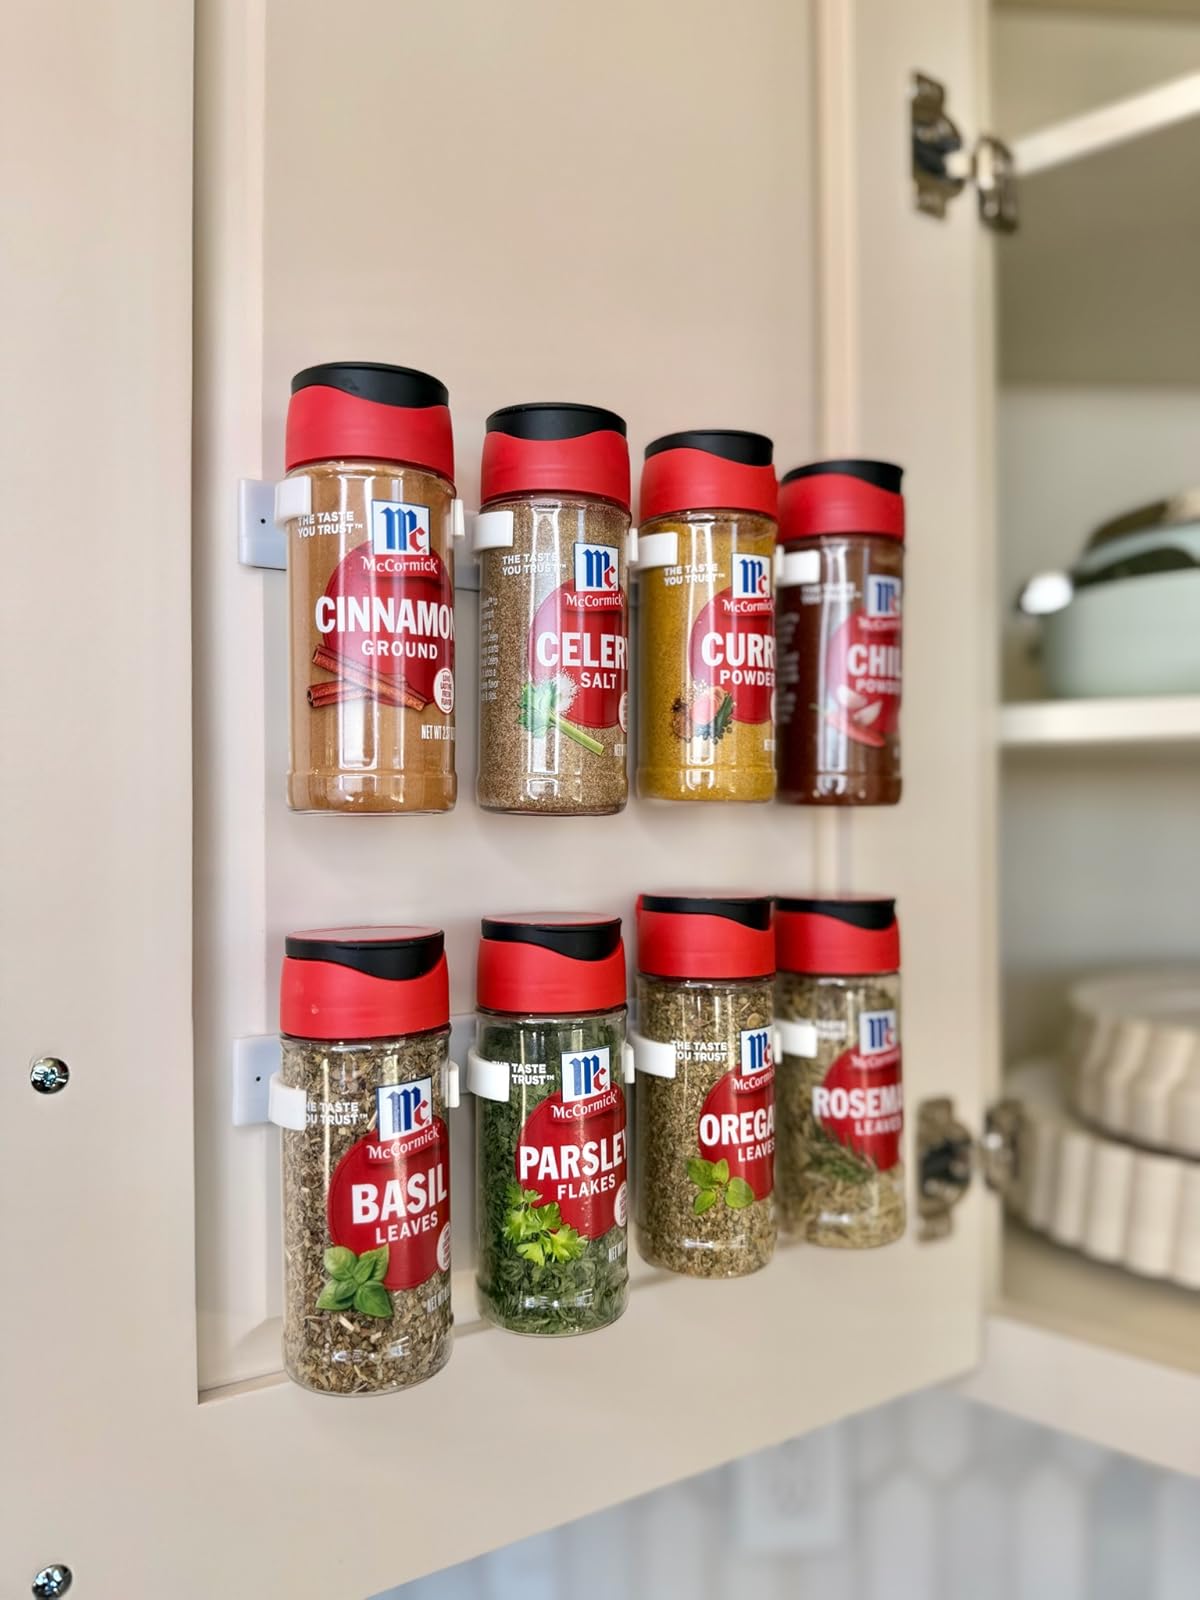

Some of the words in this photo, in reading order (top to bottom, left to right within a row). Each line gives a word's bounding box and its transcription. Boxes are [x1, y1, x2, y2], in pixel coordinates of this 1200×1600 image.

[298, 514, 315, 526] THE
[317, 511, 355, 523] TASTE
[298, 525, 316, 538] YOU
[361, 556, 439, 574] McCormick
[502, 554, 520, 565] THE
[524, 552, 560, 563] TASTE
[502, 565, 521, 576] YOU
[664, 566, 682, 576] THE
[684, 563, 718, 573] TASTE
[664, 576, 683, 586] YOU
[361, 640, 438, 659] GROUND
[536, 631, 628, 670] CELER
[581, 672, 617, 689] SALT
[694, 1042, 727, 1052] TASTE
[511, 1063, 546, 1074] TASTE
[320, 1101, 359, 1113] TASTE
[550, 1090, 617, 1118] McCormick
[366, 1124, 440, 1159] McCormick
[352, 1162, 448, 1225] BASIL
[557, 1173, 616, 1200] FLAKES
[375, 1210, 438, 1245] LEAVES
